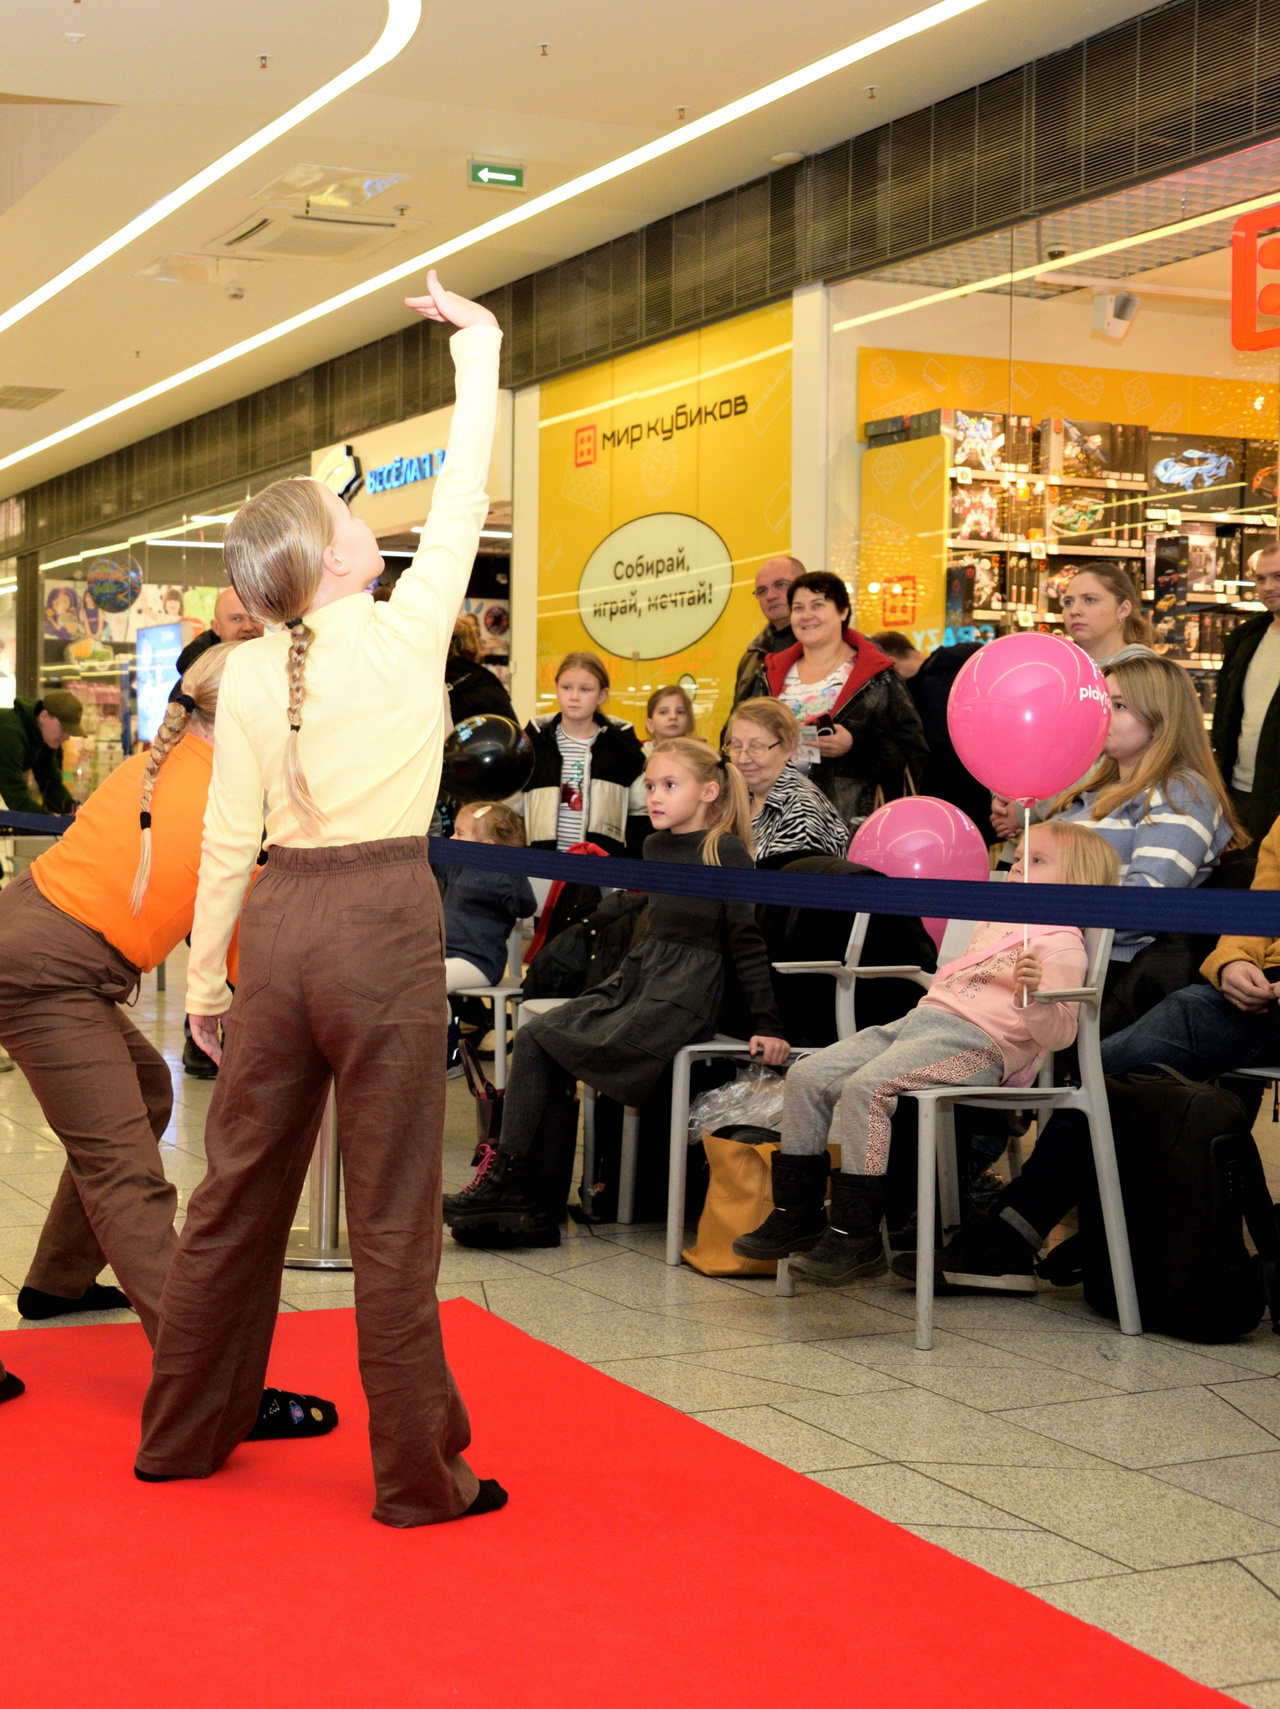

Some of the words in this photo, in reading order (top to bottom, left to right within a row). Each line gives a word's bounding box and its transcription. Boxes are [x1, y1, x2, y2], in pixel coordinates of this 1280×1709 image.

[602, 422, 643, 450] мир
[647, 394, 749, 441] кубиков
[613, 546, 691, 581] Собирай,
[592, 590, 642, 621] играй,
[647, 582, 714, 613] мечтай!
